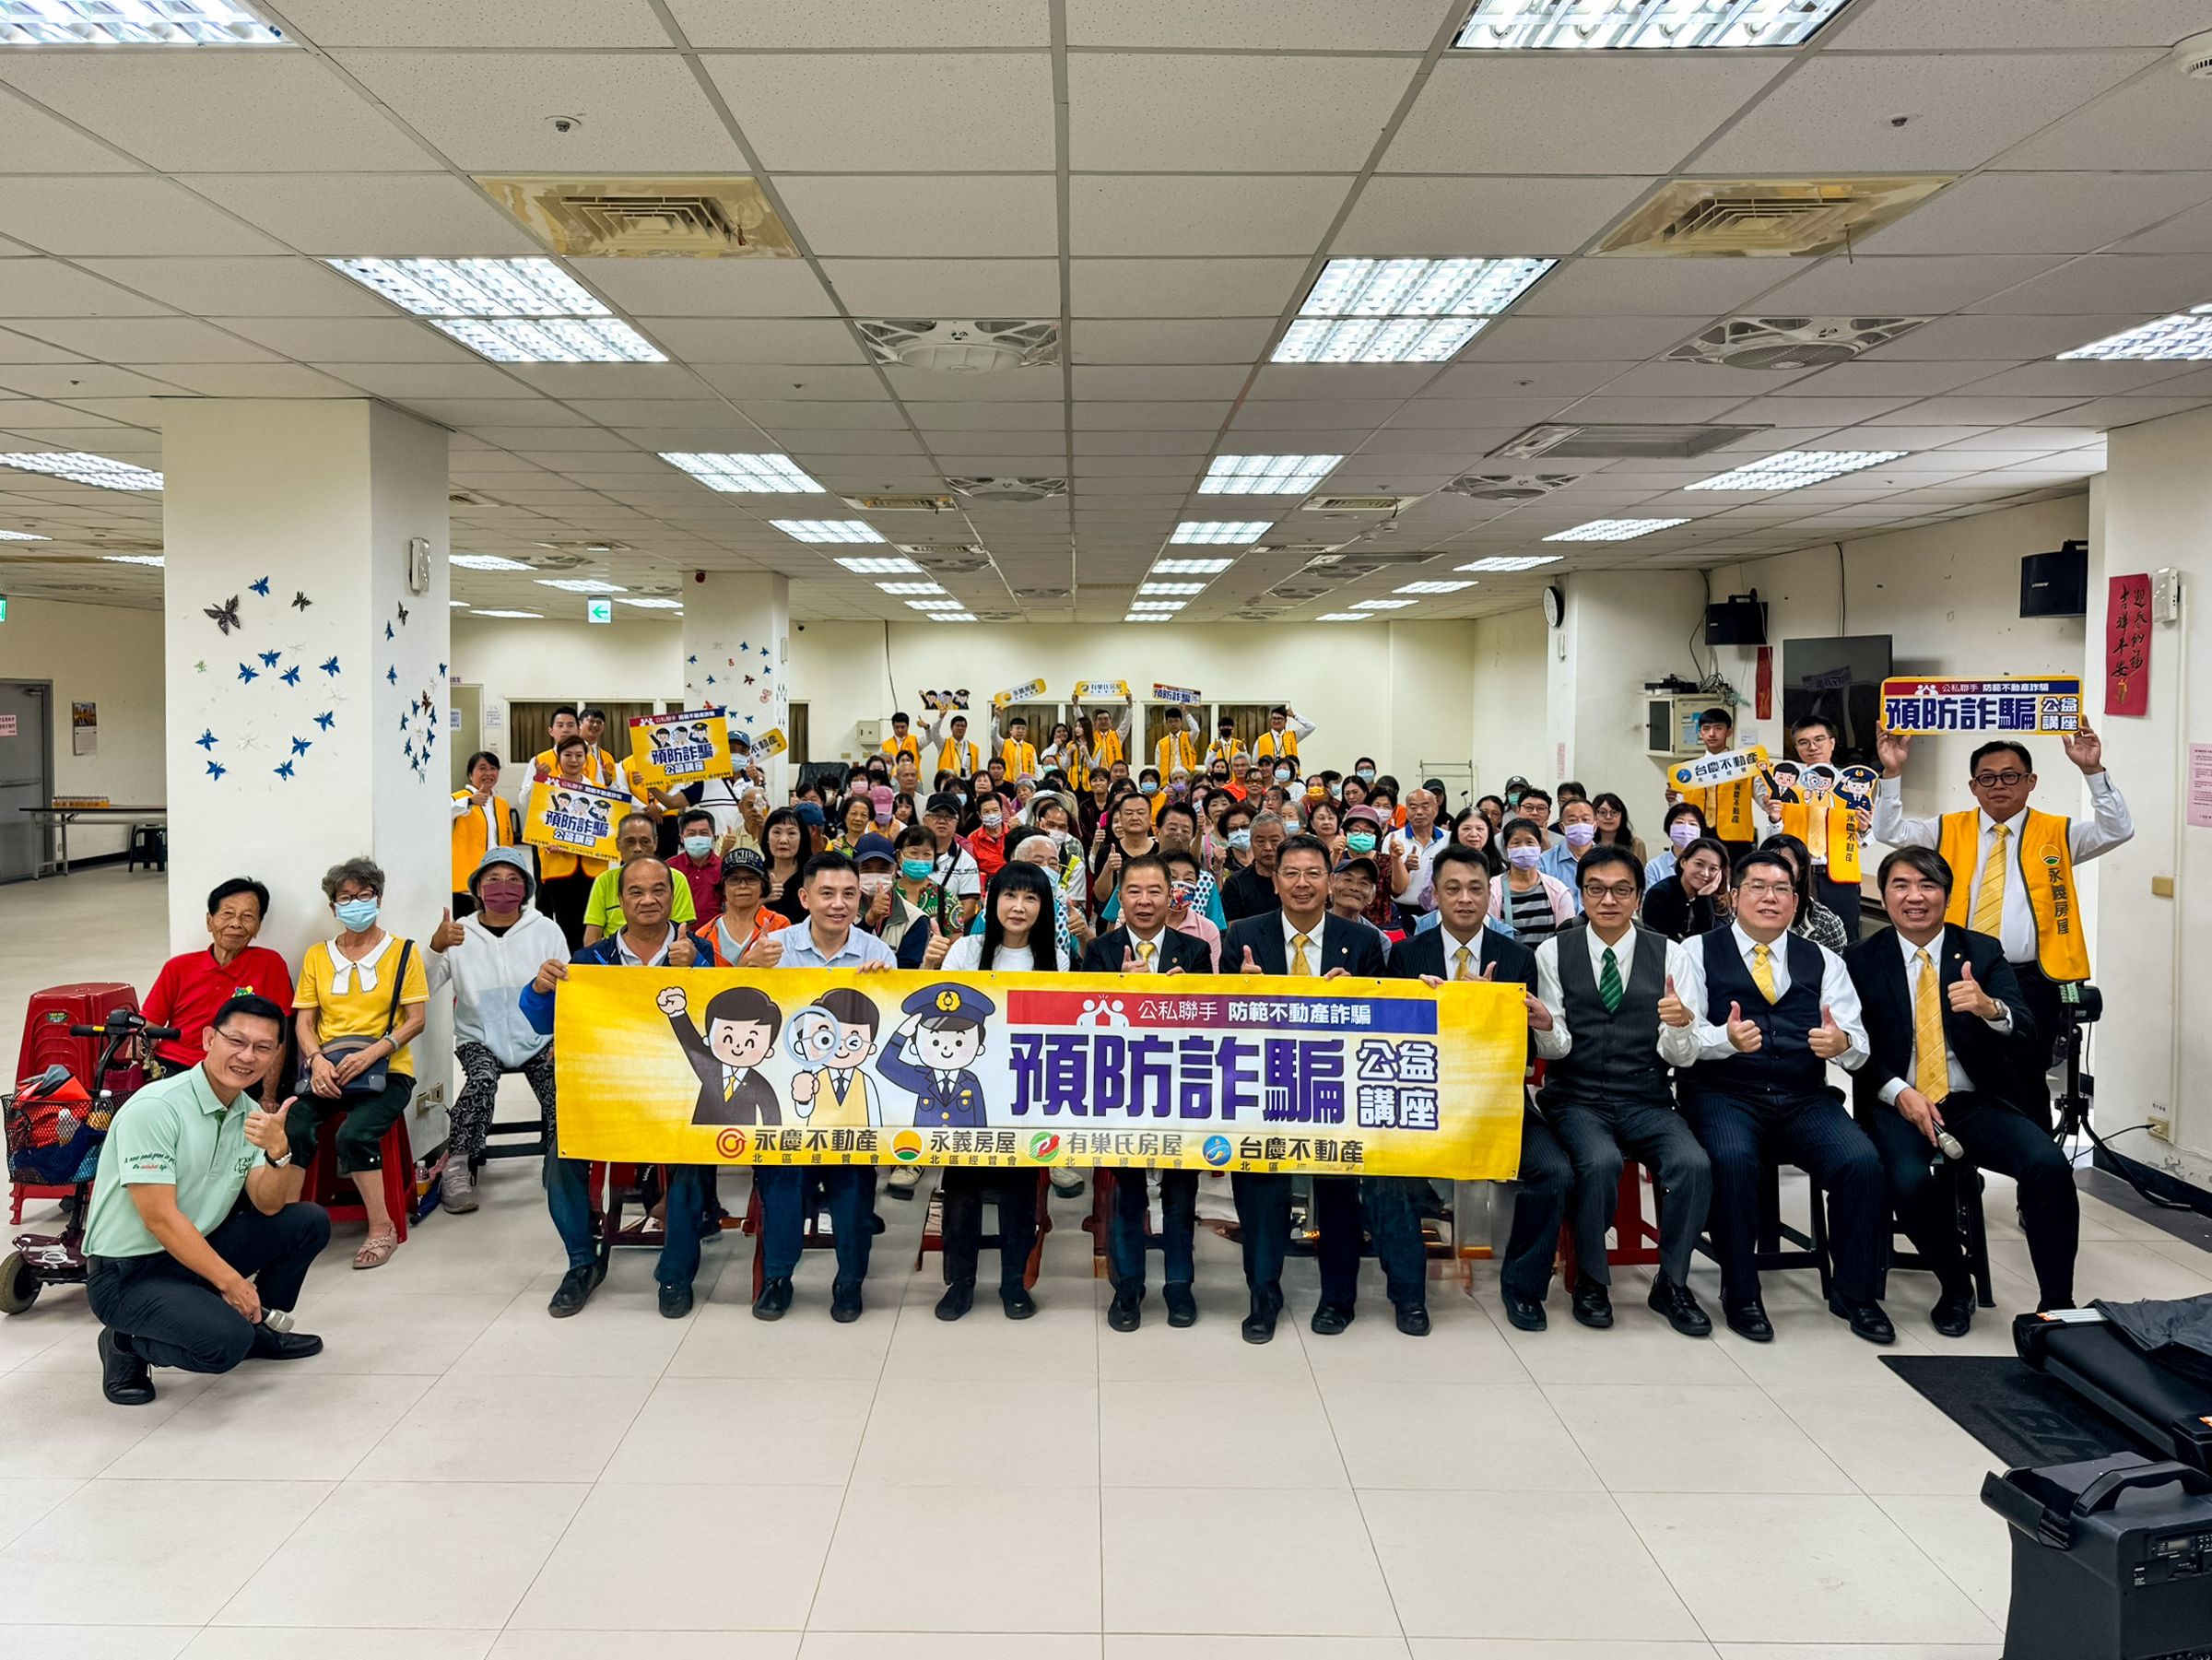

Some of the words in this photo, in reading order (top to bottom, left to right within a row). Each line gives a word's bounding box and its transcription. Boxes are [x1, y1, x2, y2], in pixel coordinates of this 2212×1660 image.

[1886, 697, 2037, 730] 預防詐騙
[2041, 696, 2078, 713] 公益
[2041, 714, 2078, 731] 講座
[652, 743, 713, 765] 預防詐騙
[546, 810, 609, 838] 預防詐騙
[1137, 999, 1218, 1021] 公私聯手
[1229, 1001, 1371, 1026] 防範不動產詐騙
[1357, 1039, 1438, 1084] 公益
[1008, 1032, 1346, 1124] 預防詐騙
[1357, 1084, 1438, 1130] 講座
[754, 1129, 877, 1152] 永慶不動產
[930, 1130, 1016, 1153] 永義房屋
[1066, 1132, 1182, 1156] 有巢氏房屋
[1240, 1136, 1364, 1163] 台慶不動產
